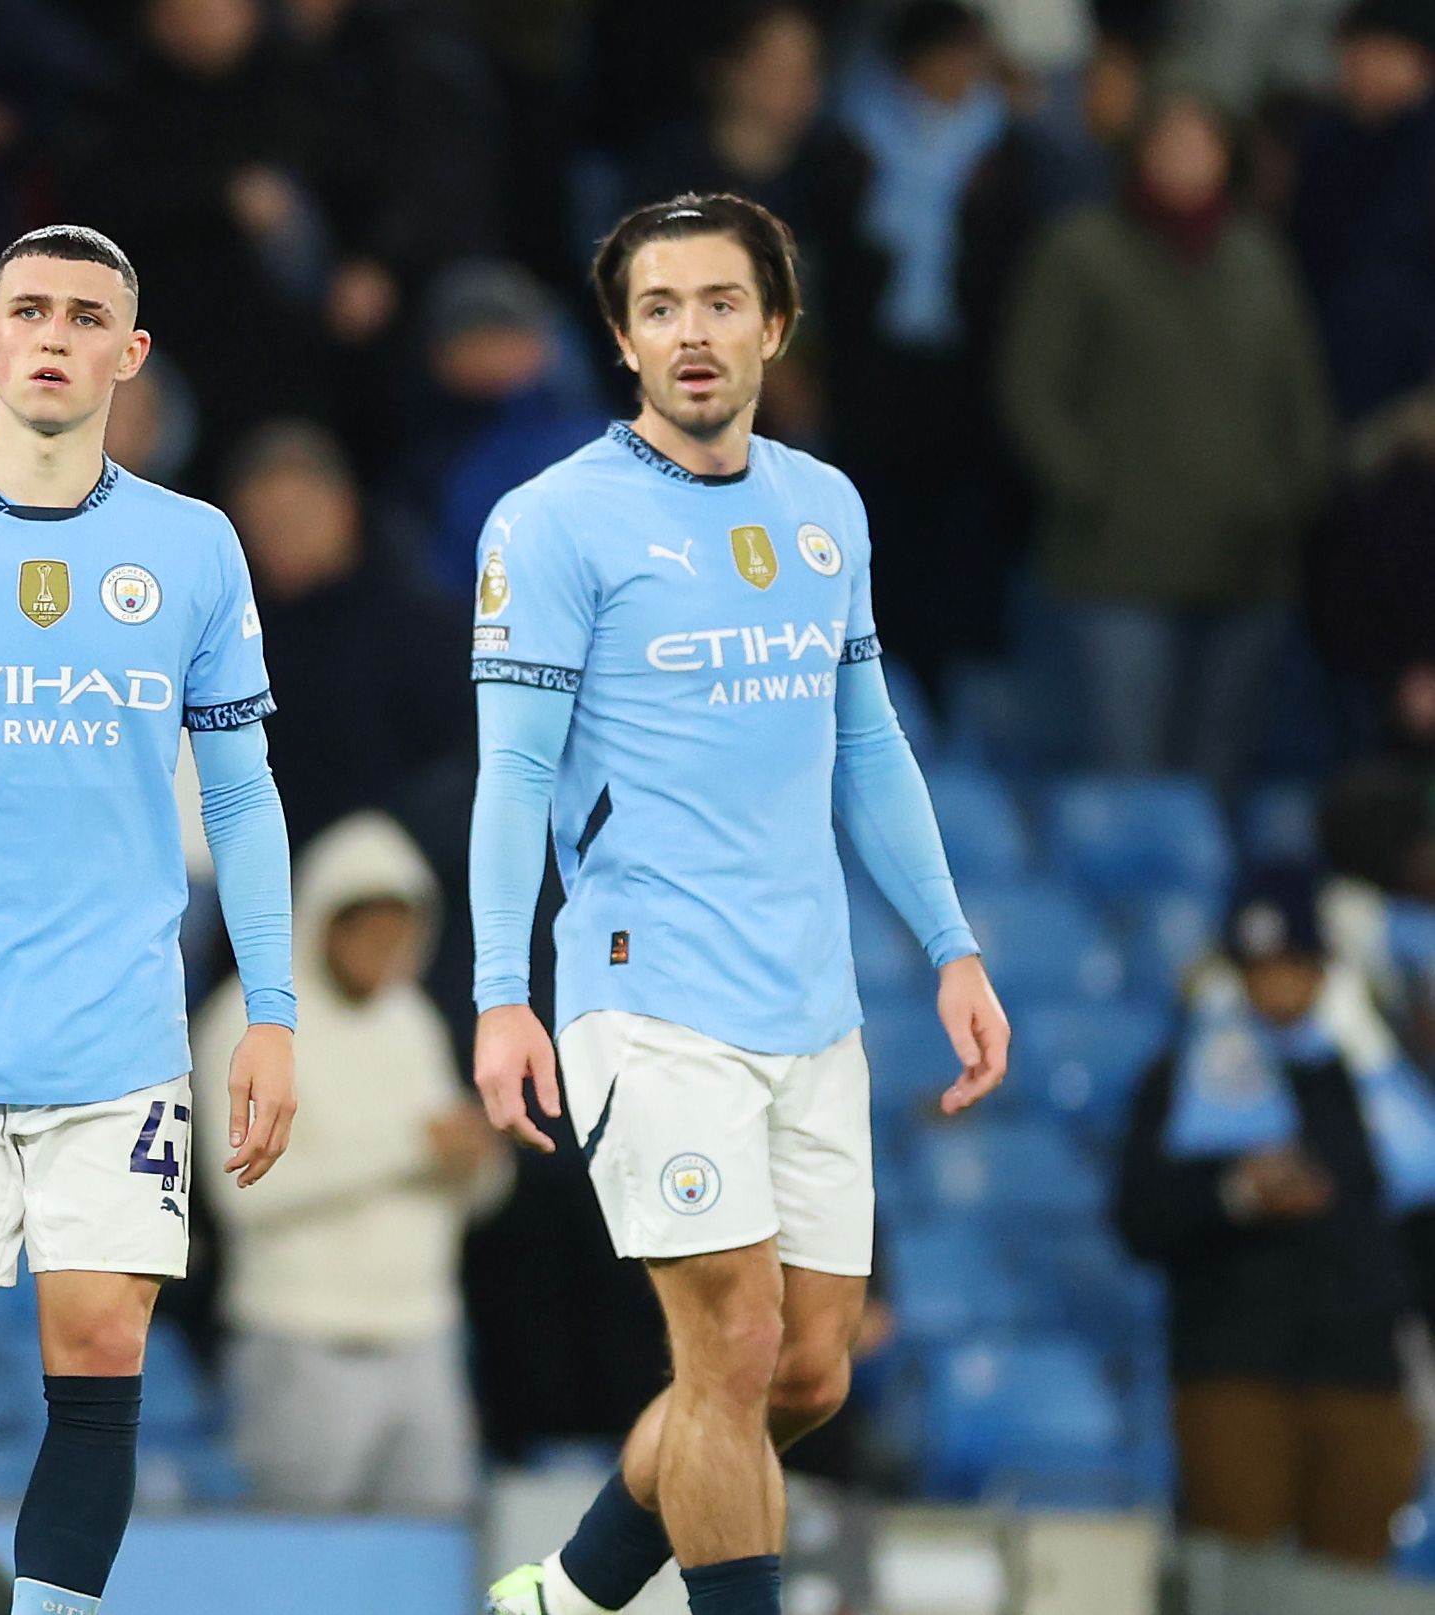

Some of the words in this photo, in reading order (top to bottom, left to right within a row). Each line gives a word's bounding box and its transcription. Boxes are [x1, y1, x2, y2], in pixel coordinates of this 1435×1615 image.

[748, 565, 769, 575] FIFA
[107, 568, 155, 590] MANCHESTER
[32, 602, 57, 612] FIFA
[121, 613, 140, 621] CITY
[708, 671, 833, 706] AIRWAYS
